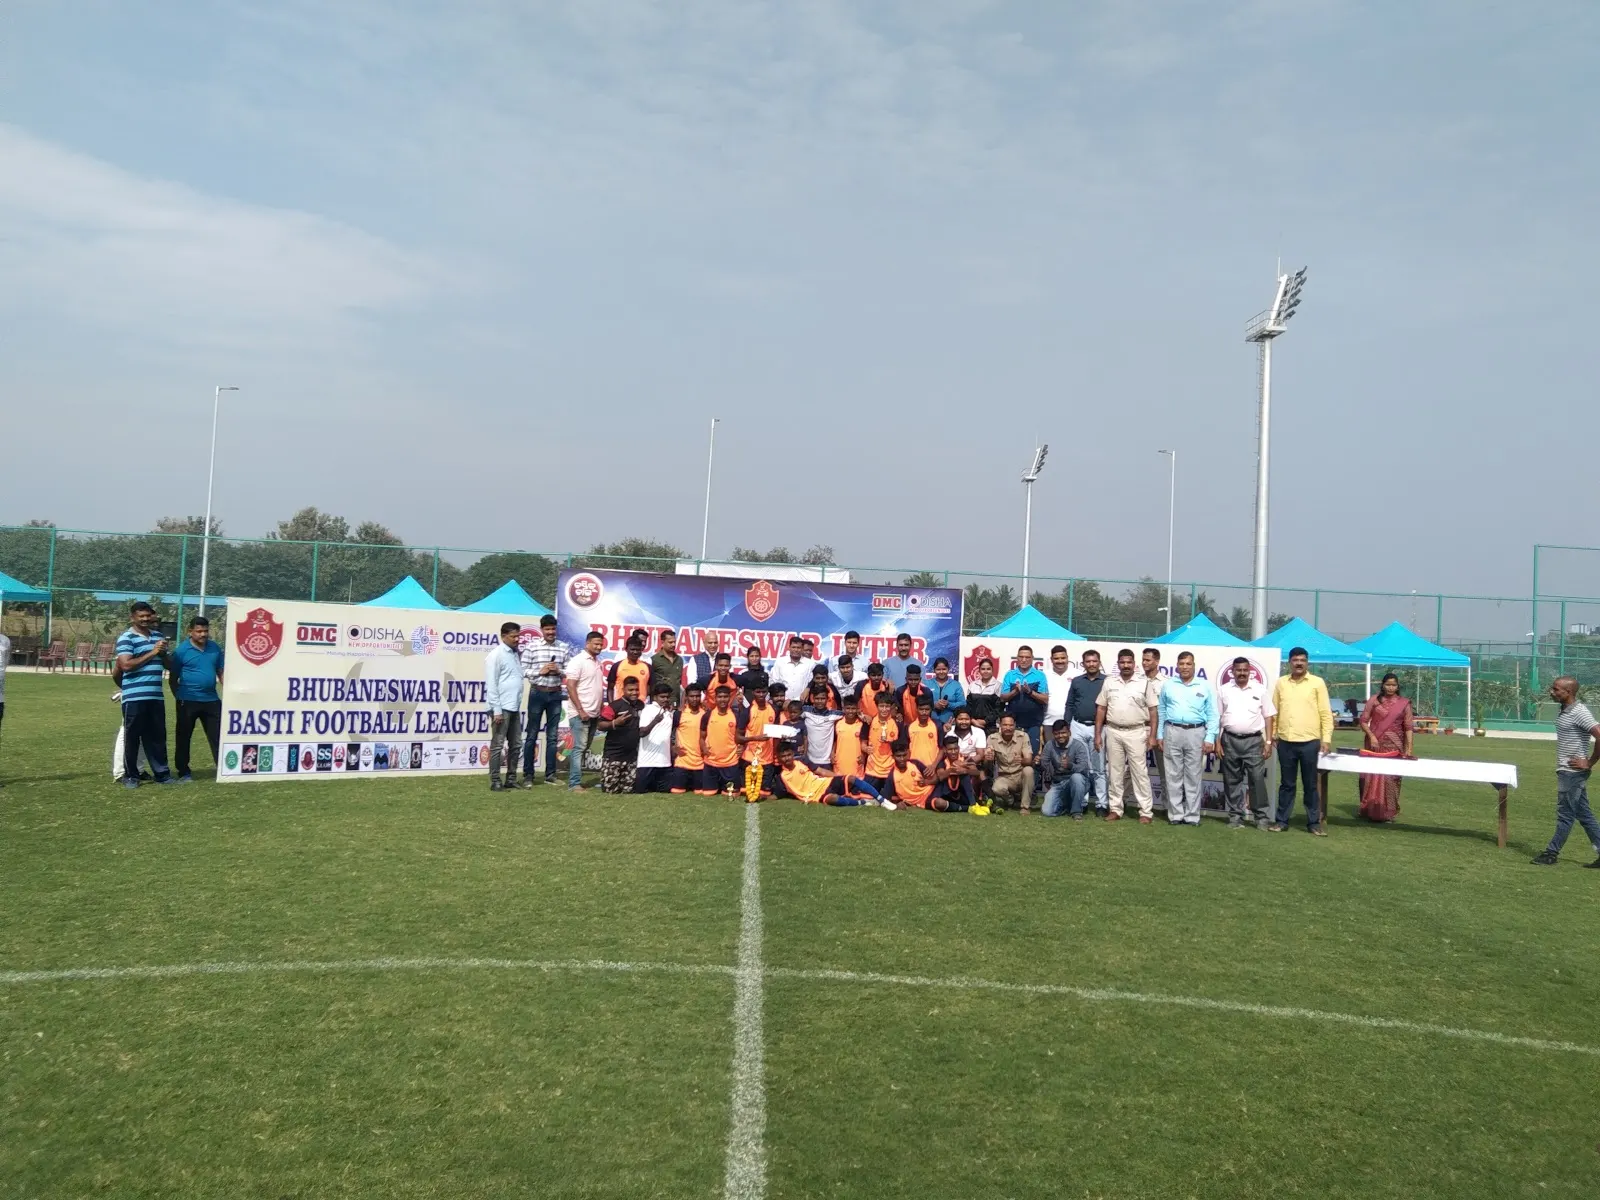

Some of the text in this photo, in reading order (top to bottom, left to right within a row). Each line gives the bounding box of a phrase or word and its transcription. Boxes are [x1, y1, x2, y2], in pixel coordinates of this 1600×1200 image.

[873, 595, 952, 608] OMC ODISHA
[297, 625, 404, 642] OMC ODISHA
[443, 631, 499, 645] ODISHA
[287, 677, 487, 702] BHUBANESWAR INT
[227, 710, 489, 735] BASTI FOOTBALL LEAGUE
